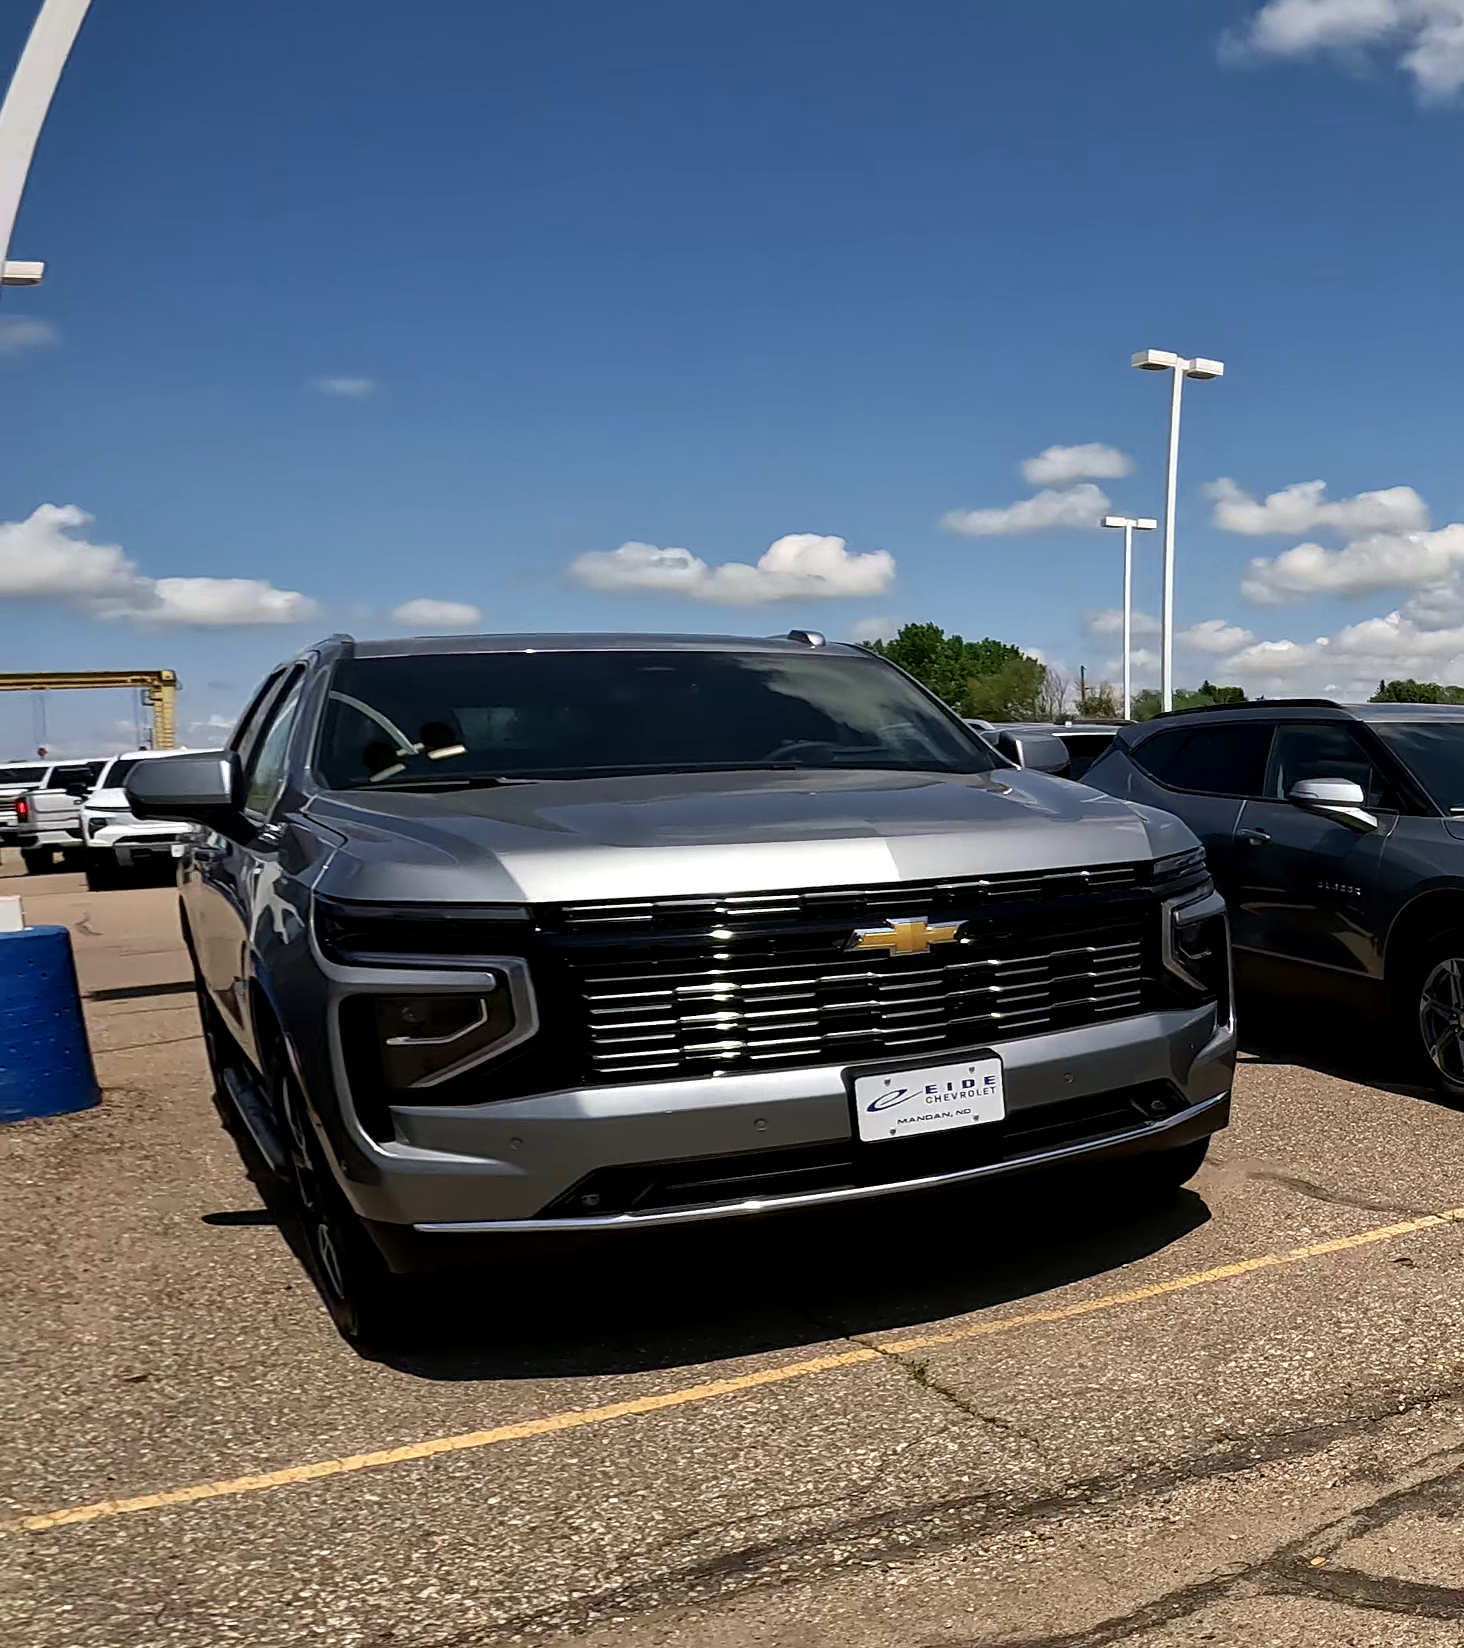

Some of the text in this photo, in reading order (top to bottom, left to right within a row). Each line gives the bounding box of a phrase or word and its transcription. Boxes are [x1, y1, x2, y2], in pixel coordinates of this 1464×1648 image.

[925, 1075, 996, 1094] EIDE
[926, 1086, 997, 1104] CHEVROLET
[897, 1108, 971, 1124] MANDAN, ND
